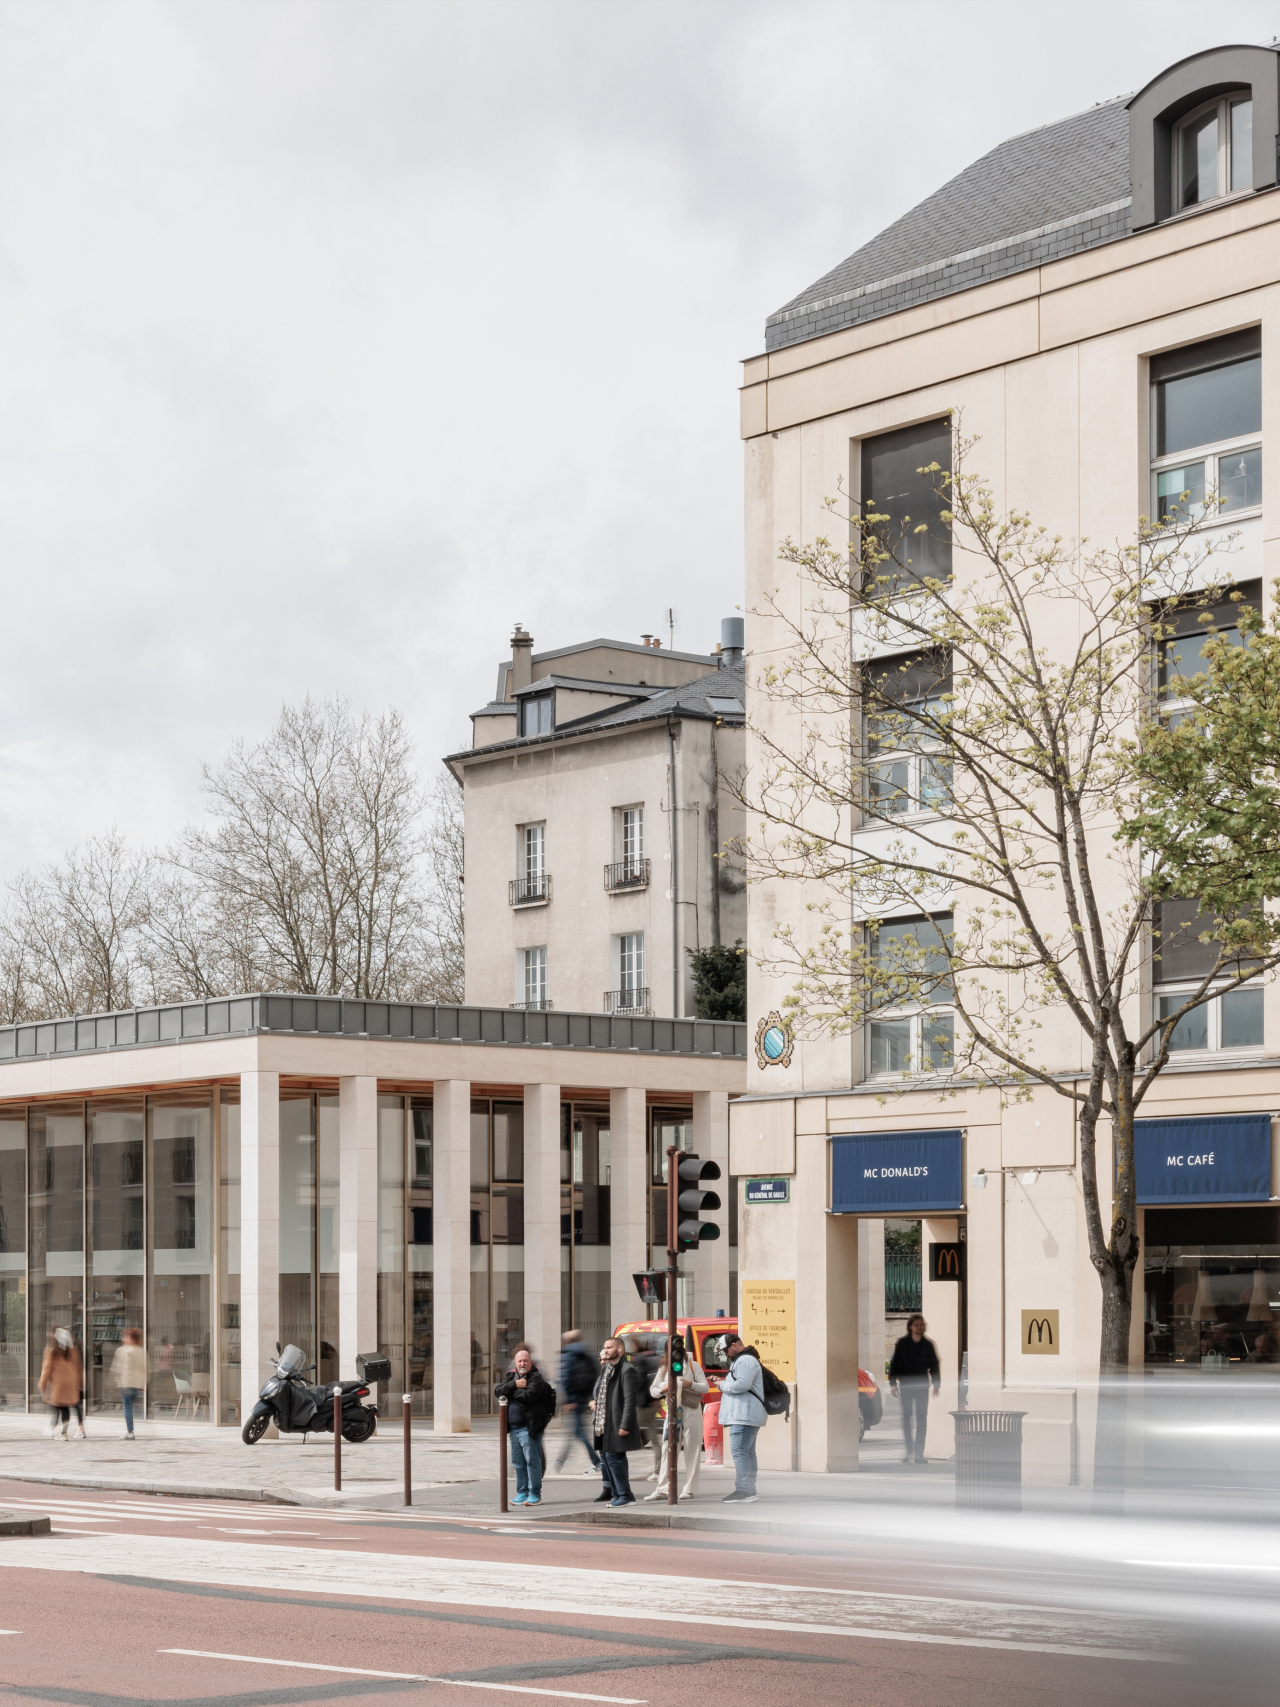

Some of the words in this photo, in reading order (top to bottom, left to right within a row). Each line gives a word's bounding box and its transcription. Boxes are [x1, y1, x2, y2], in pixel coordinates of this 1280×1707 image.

[1167, 1155, 1184, 1167] MC
[1187, 1151, 1215, 1166] CAFÉ
[863, 1168, 878, 1179] MC
[881, 1166, 928, 1178] DONALD'S
